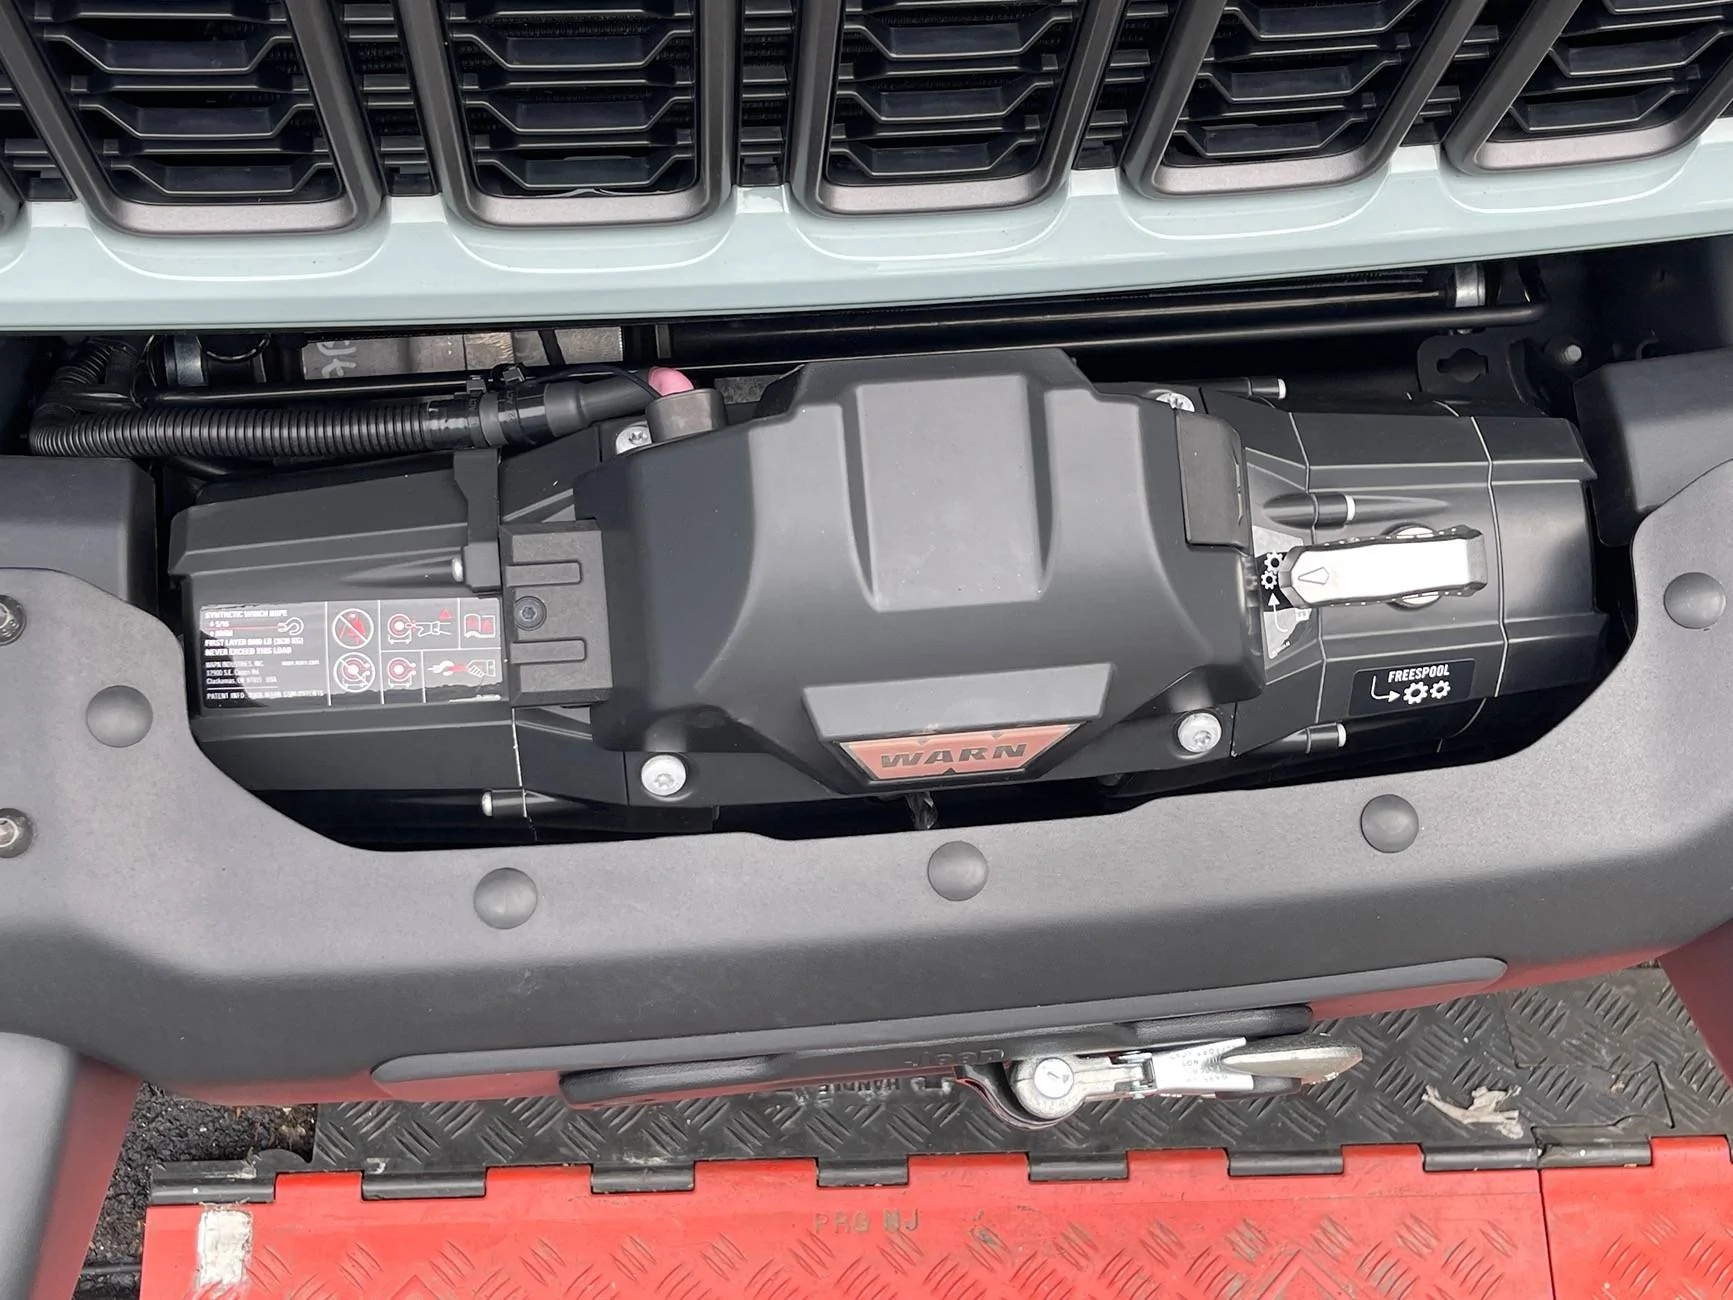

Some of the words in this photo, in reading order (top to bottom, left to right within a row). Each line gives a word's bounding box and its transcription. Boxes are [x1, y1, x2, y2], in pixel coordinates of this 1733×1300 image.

[205, 611, 243, 619] SYNTHETIC
[268, 609, 288, 617] ROPE
[204, 639, 224, 647] FIRST
[225, 638, 247, 646] LAYER
[205, 648, 228, 656] NEVER
[229, 647, 256, 655] EXCEED
[273, 646, 292, 654] LOAD
[1388, 664, 1450, 683] FREESPOOL
[881, 744, 1028, 768] WARN
